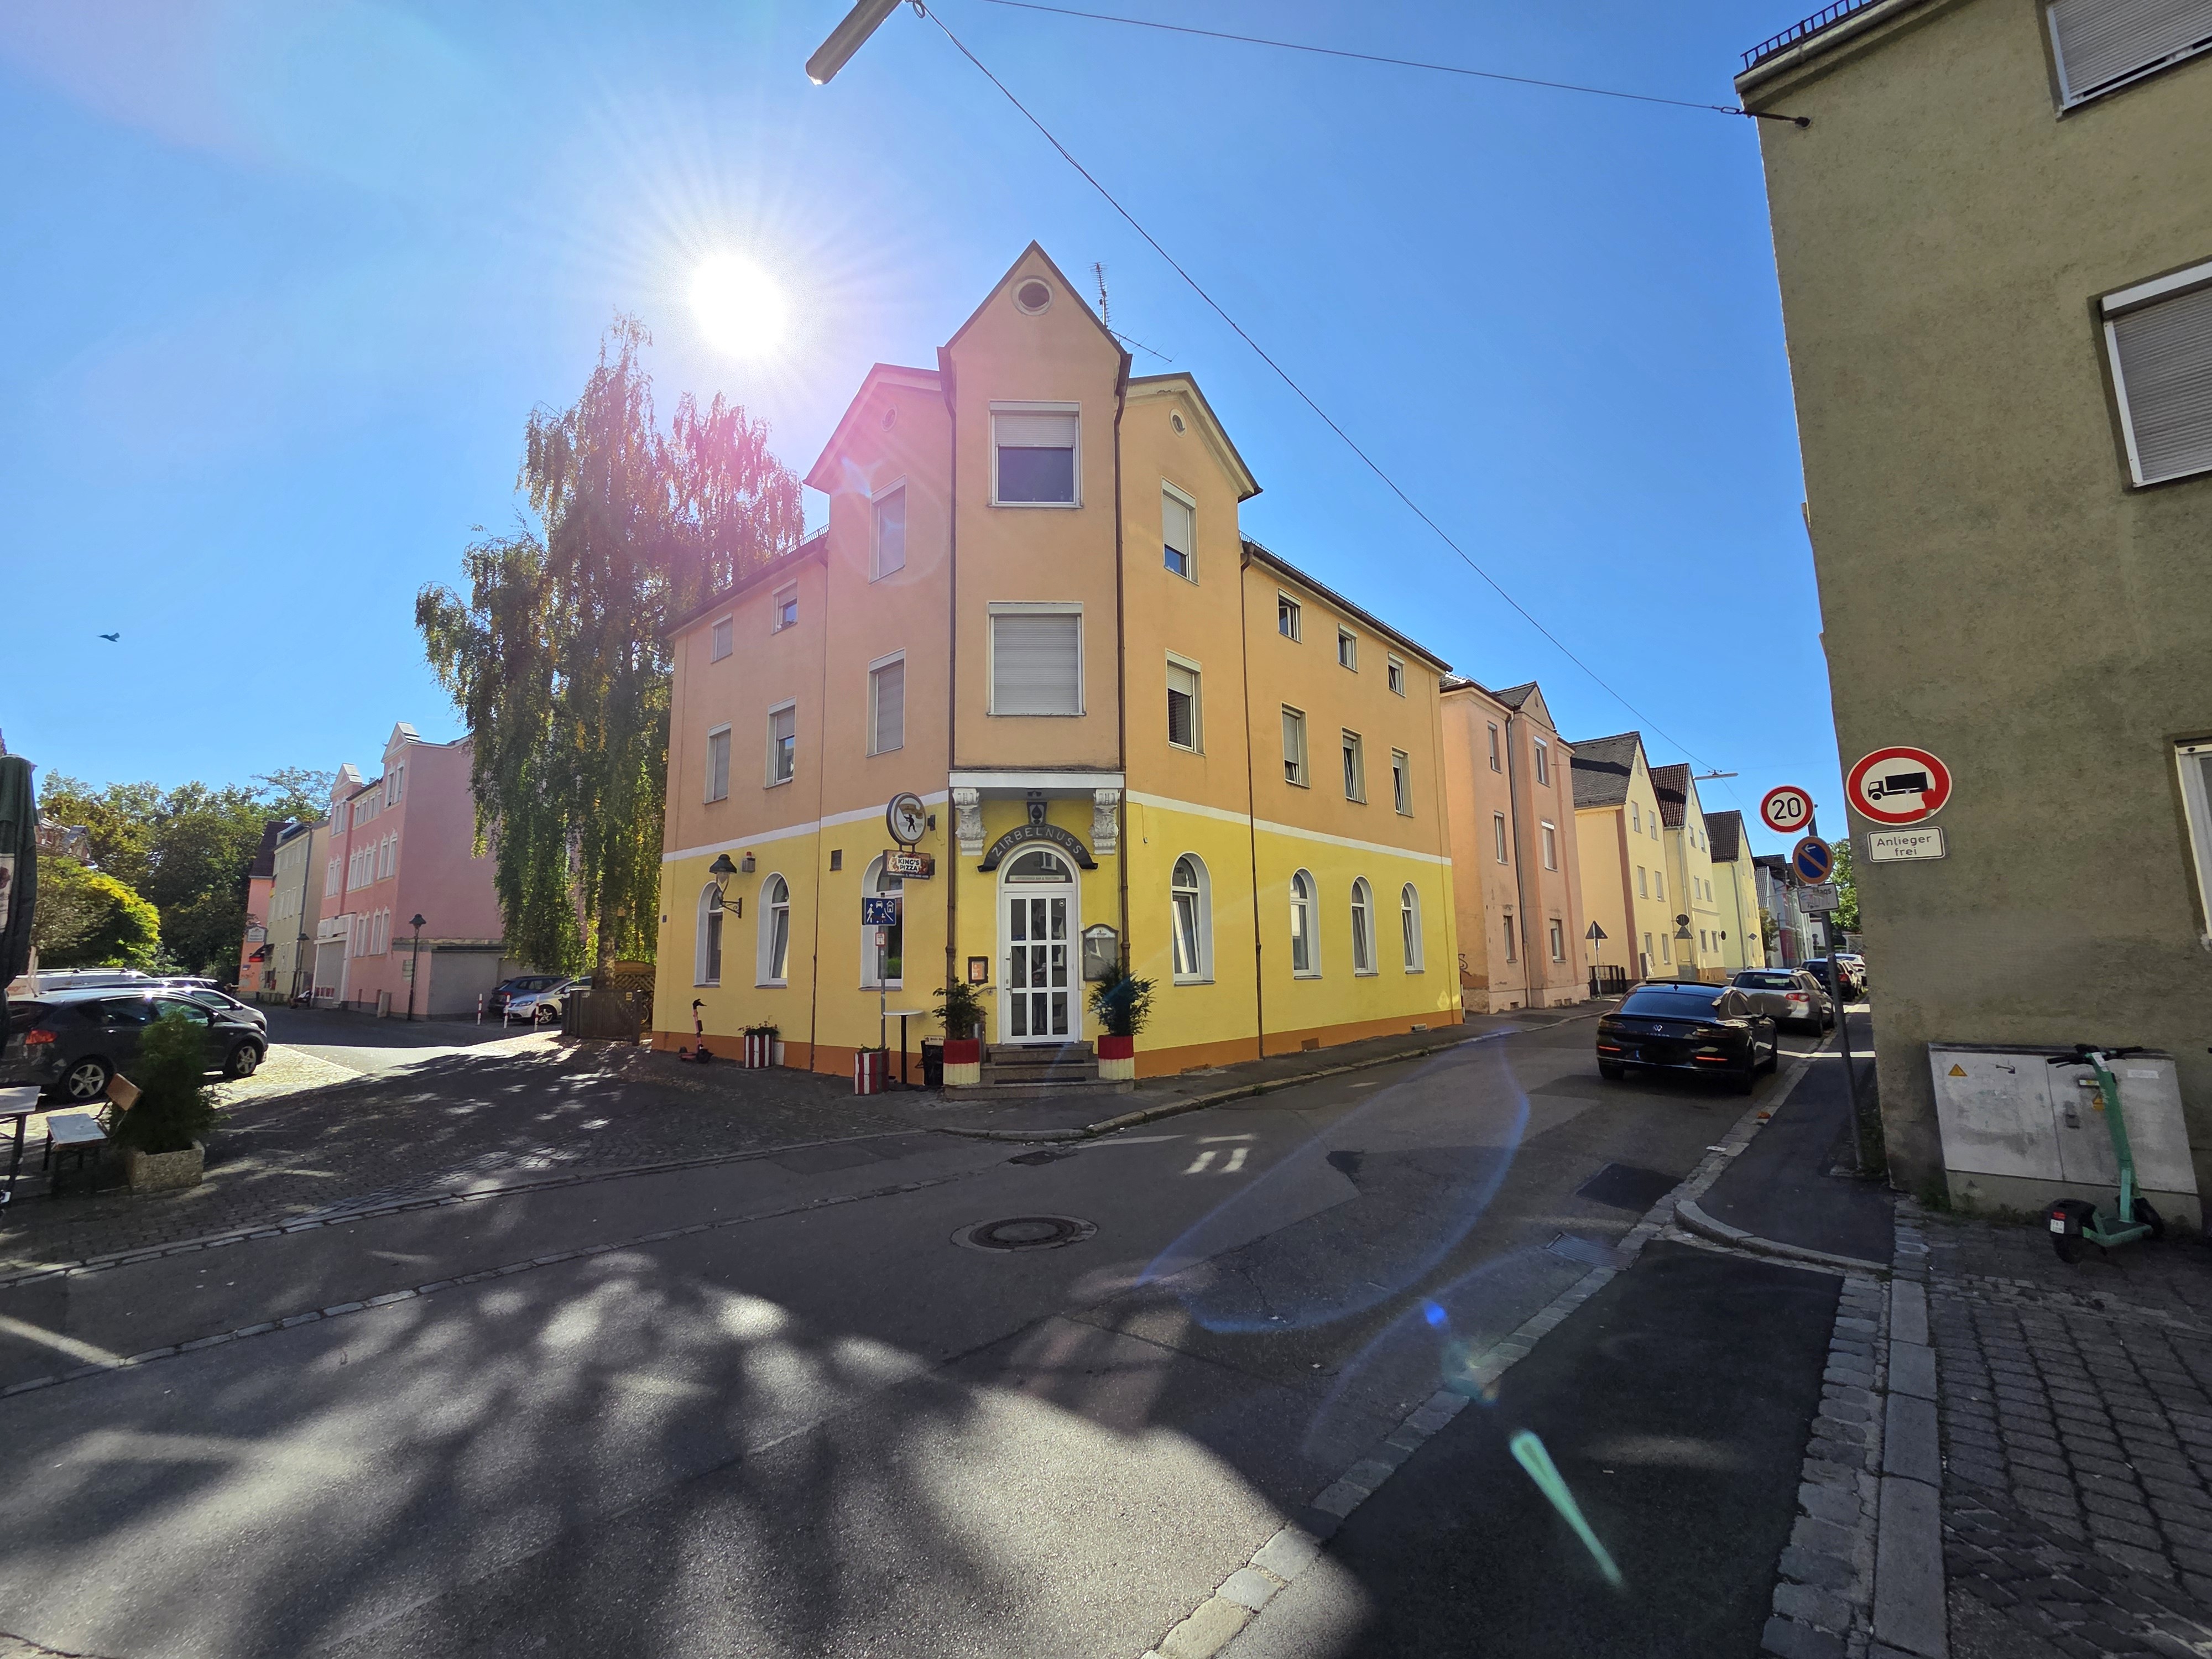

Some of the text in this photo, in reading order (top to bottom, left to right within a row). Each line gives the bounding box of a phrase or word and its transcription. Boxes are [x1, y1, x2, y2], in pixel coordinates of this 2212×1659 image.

[1772, 797, 1802, 820] 20
[991, 826, 1082, 858] ZIRBELNUSS
[1876, 836, 1932, 847] Anlieger
[1895, 846, 1917, 856] frei
